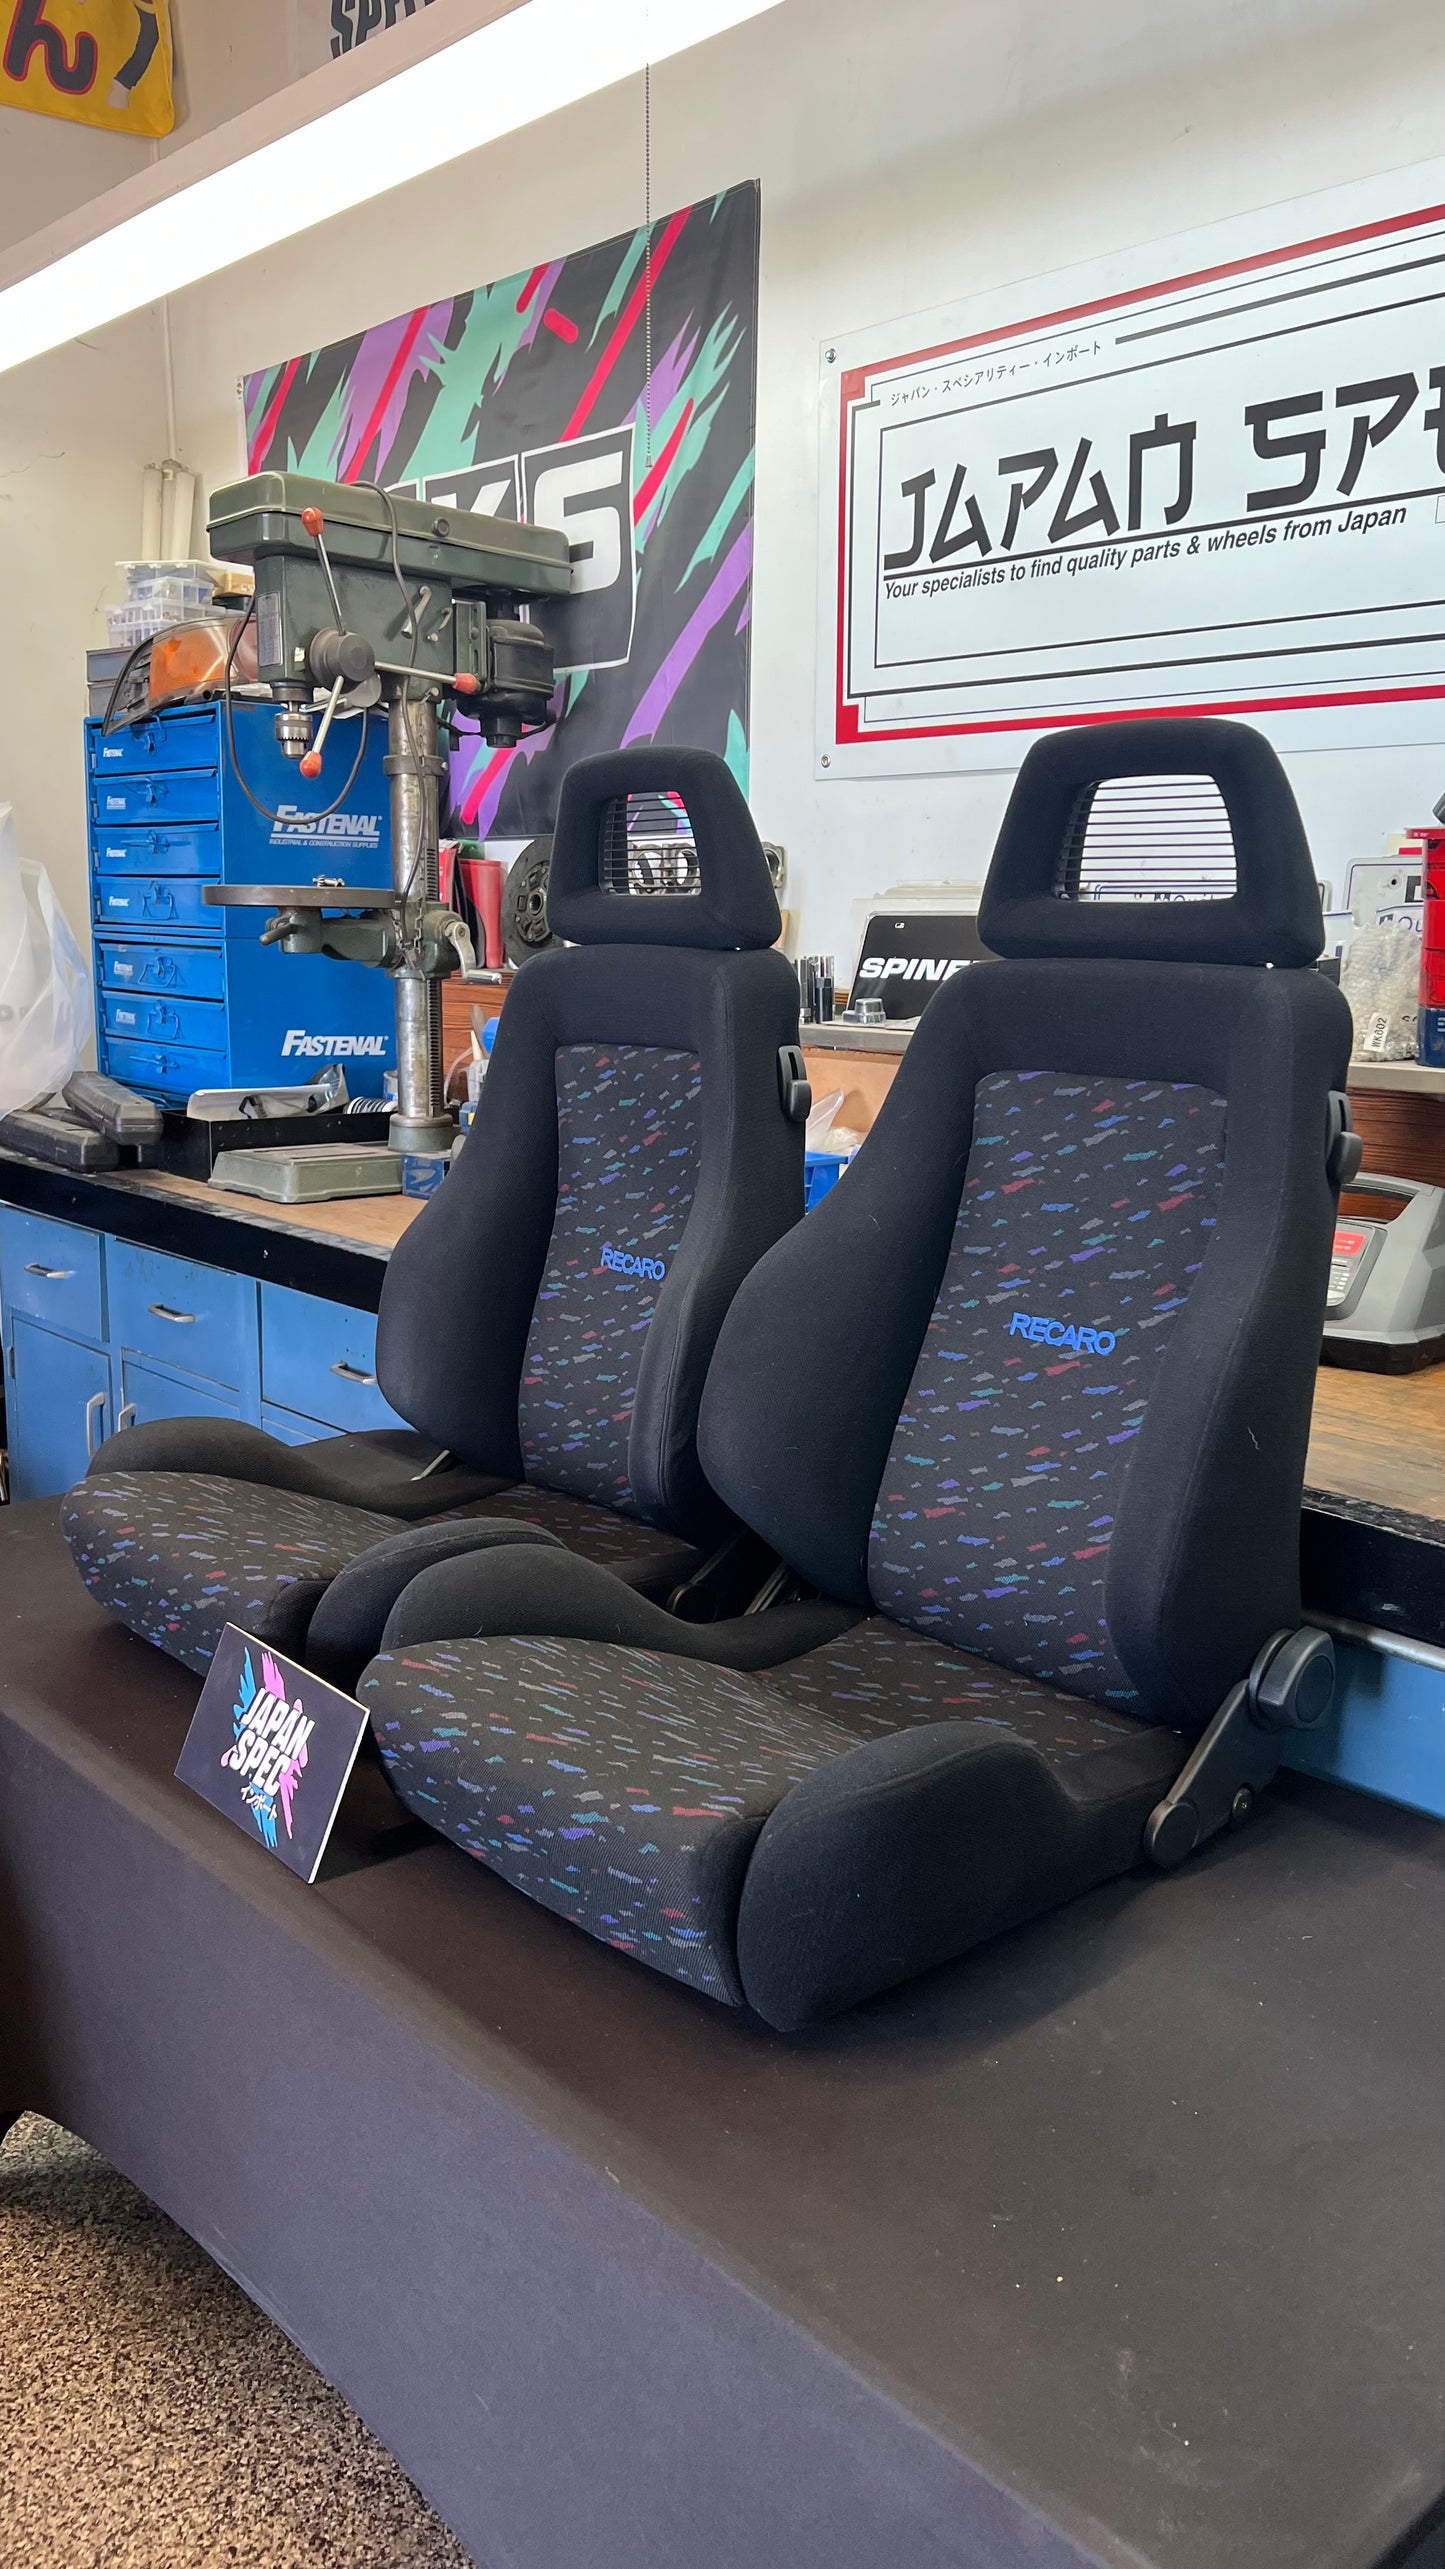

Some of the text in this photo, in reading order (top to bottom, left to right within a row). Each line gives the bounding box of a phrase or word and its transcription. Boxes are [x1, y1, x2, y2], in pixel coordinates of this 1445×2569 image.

[883, 412, 1197, 571] JAPAN
[885, 507, 1407, 599] Your specialists to find quality parts & wheels from Japan
[281, 1029, 386, 1057] FASTENAL
[600, 1247, 666, 1280] RECARO
[1009, 1312, 1116, 1356] RECARO
[240, 1687, 316, 1761] JAPAN
[229, 1729, 292, 1797] SPEC
[240, 1785, 278, 1820] インポート
